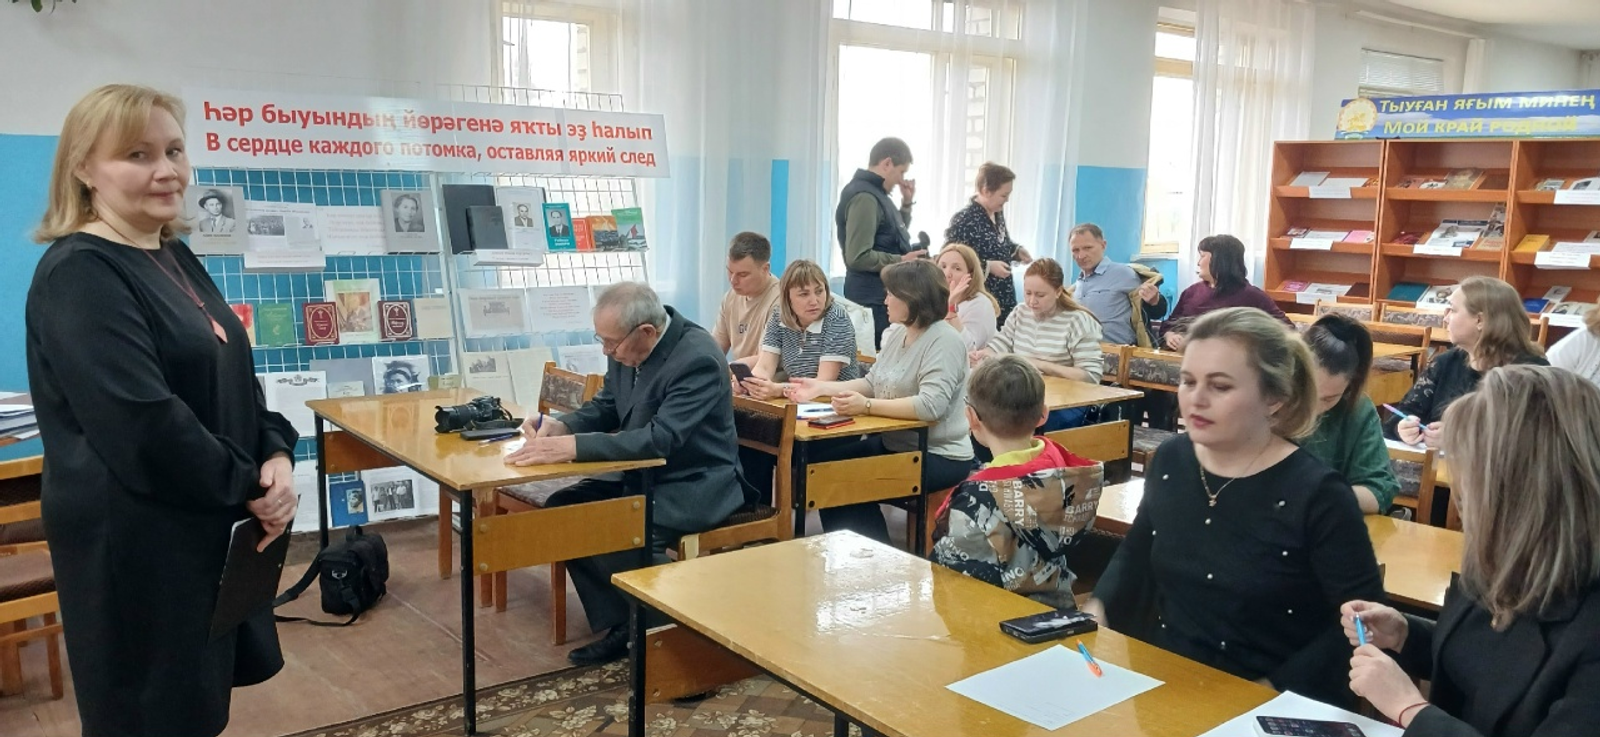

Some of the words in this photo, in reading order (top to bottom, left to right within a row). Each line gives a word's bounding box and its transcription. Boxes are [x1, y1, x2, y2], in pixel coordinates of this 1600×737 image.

[203, 101, 254, 126] Һәр
[261, 103, 397, 130] быуындың
[403, 108, 504, 134] йөрәгенә
[510, 119, 562, 137] яҡты
[566, 123, 588, 141] эҙ
[591, 120, 653, 140] һалып
[206, 132, 221, 152] В
[227, 136, 304, 157] сердце
[309, 139, 395, 158] каждого
[400, 141, 482, 162] потомка,
[486, 144, 564, 162] оставляя
[568, 146, 617, 167] яркий
[619, 150, 657, 168] след
[1013, 480, 1025, 527] BARRY
